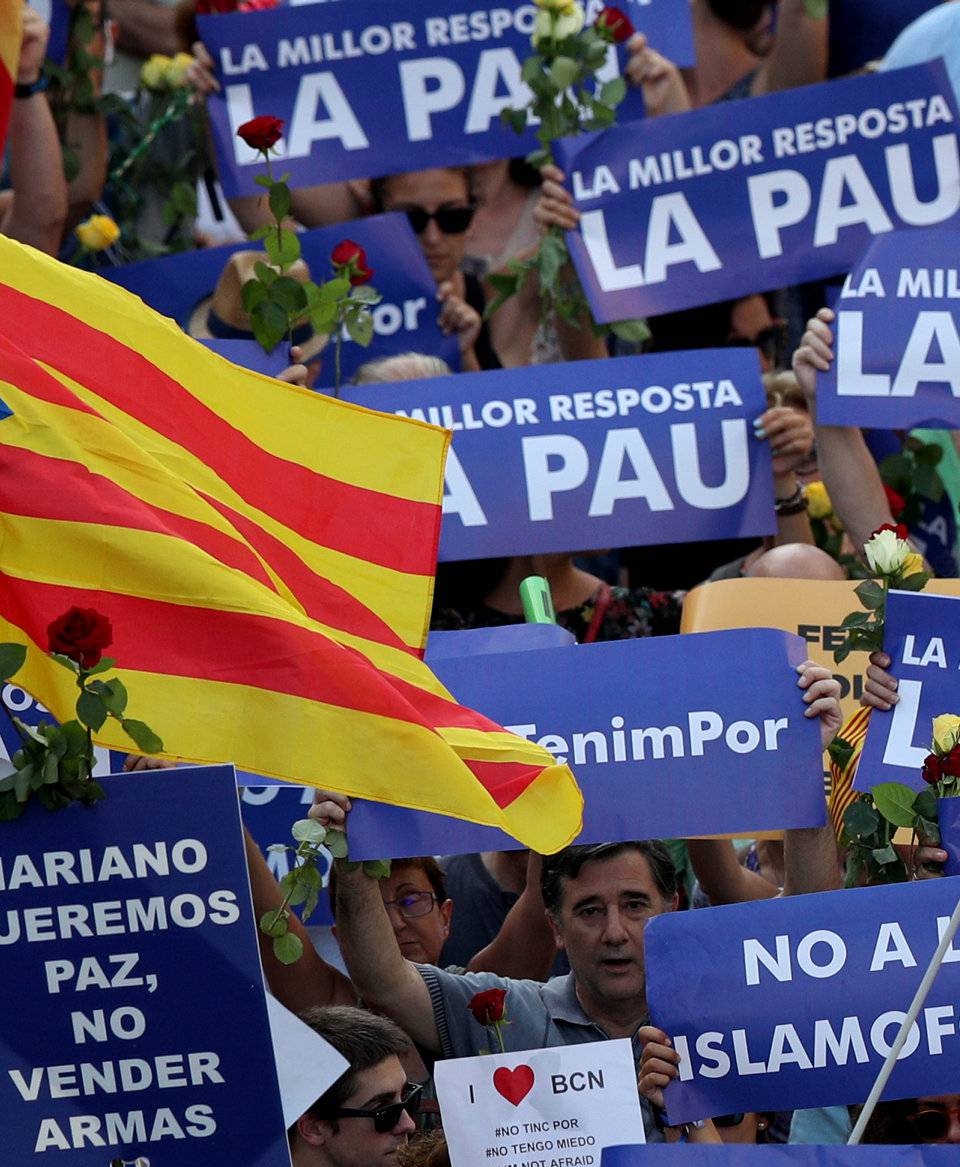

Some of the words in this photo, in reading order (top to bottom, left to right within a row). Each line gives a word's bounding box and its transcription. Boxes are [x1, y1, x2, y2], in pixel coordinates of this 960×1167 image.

[220, 45, 269, 76] LA
[277, 20, 416, 68] MILLOR
[224, 71, 370, 166] LA
[572, 166, 620, 200] LA
[628, 135, 764, 190] MILLOR
[772, 94, 953, 159] RESPOSTA
[579, 191, 723, 293] LA
[747, 133, 960, 260] PAU
[840, 268, 886, 299] LA
[837, 311, 960, 398] LA
[549, 379, 743, 423] RESPOSTA
[521, 418, 750, 522] PAU
[902, 634, 947, 669] LA
[44, 952, 158, 994] PAZ,
[743, 929, 848, 986] NO
[869, 922, 918, 972] A
[70, 1005, 147, 1045] NO
[8, 1051, 226, 1102] VENDER
[469, 1084, 475, 1104] I
[551, 1069, 605, 1095] BCN
[33, 1104, 217, 1153] ARMAS
[486, 1144, 509, 1158] #NO
[511, 1139, 554, 1154] TENGO
[556, 1135, 596, 1150] MIEDO
[495, 1124, 520, 1138] #NO
[522, 1121, 550, 1134] TINC
[553, 1118, 579, 1131] POR
